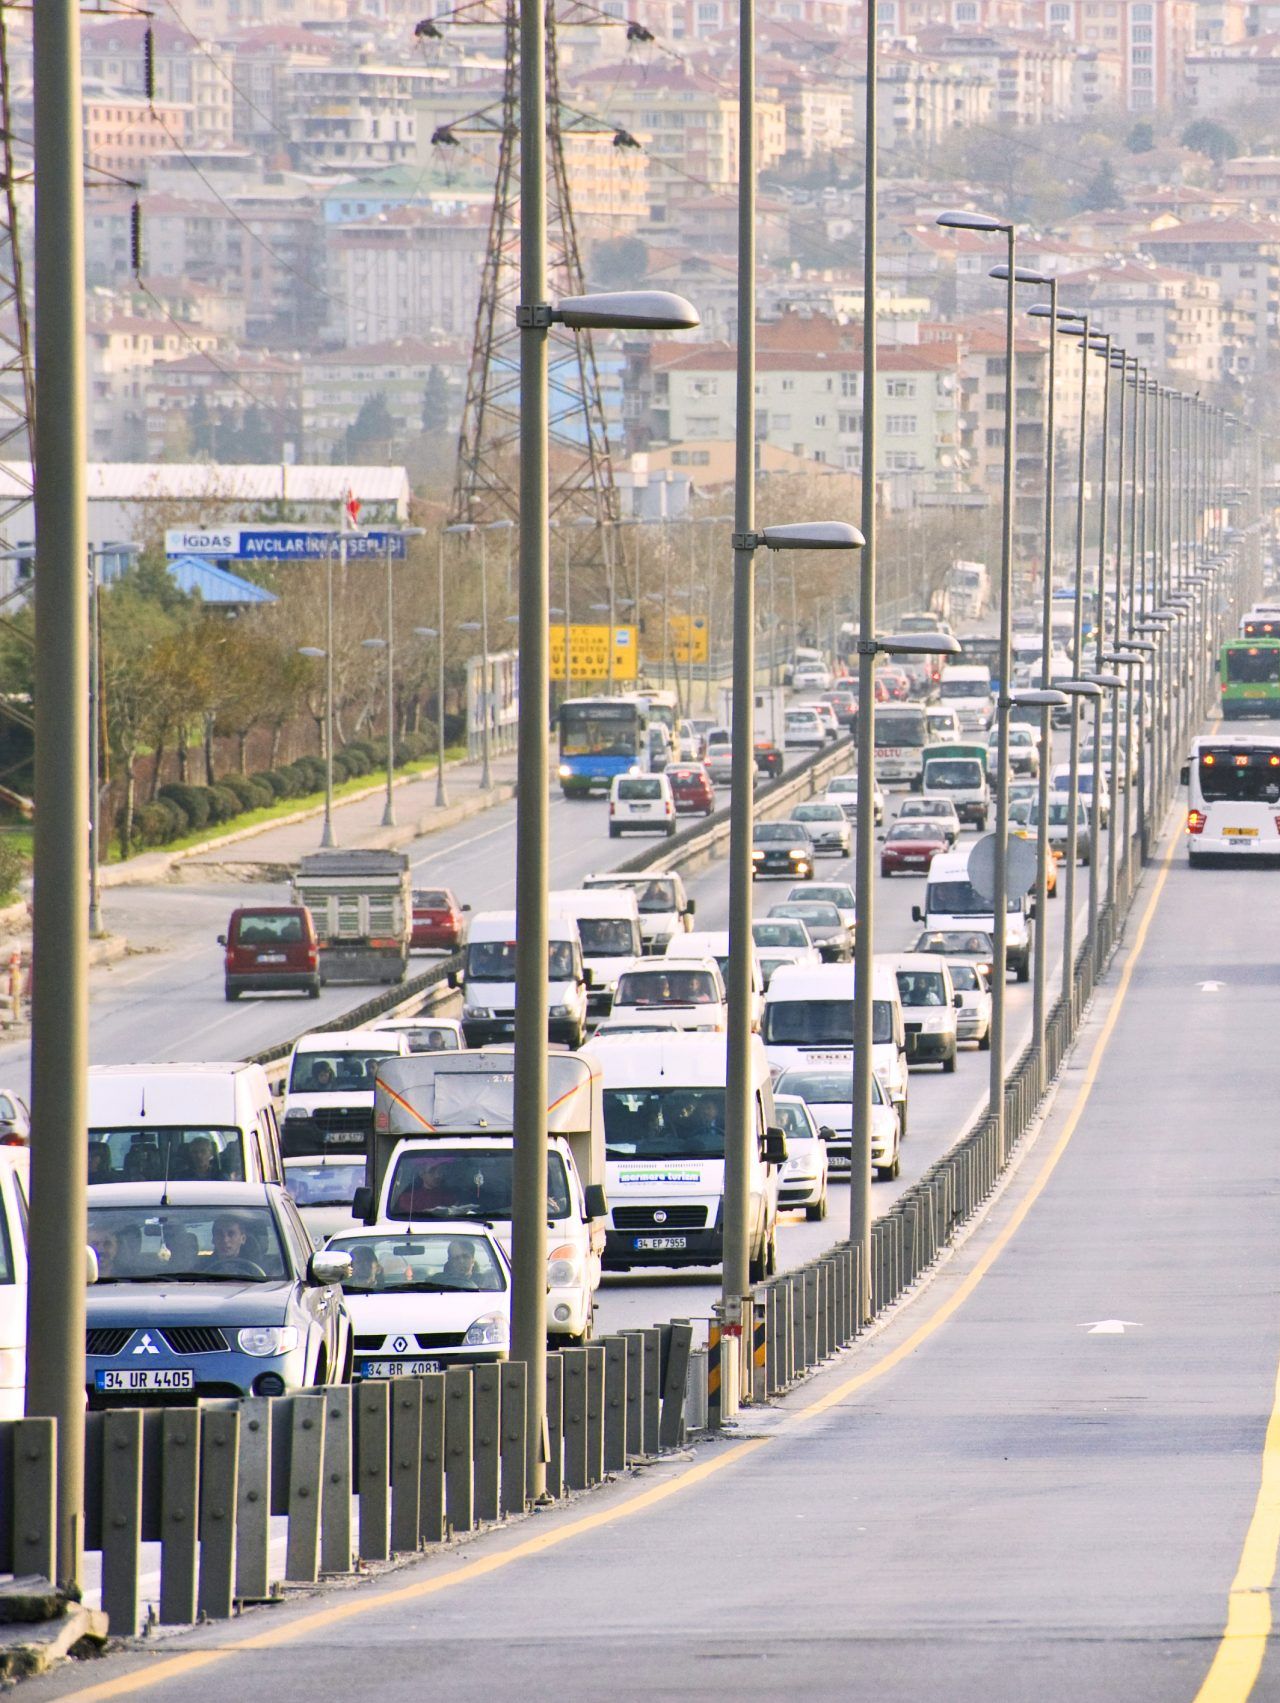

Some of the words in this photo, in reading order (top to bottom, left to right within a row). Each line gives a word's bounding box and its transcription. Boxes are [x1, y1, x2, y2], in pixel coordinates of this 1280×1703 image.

[638, 1240, 648, 1248] 34
[653, 1239, 663, 1248] EP
[665, 1239, 685, 1248] 7955
[368, 1363, 382, 1375] 34
[389, 1363, 403, 1375] BR
[106, 1372, 123, 1387] 34
[130, 1372, 147, 1387] UR
[154, 1371, 190, 1387] 4405
